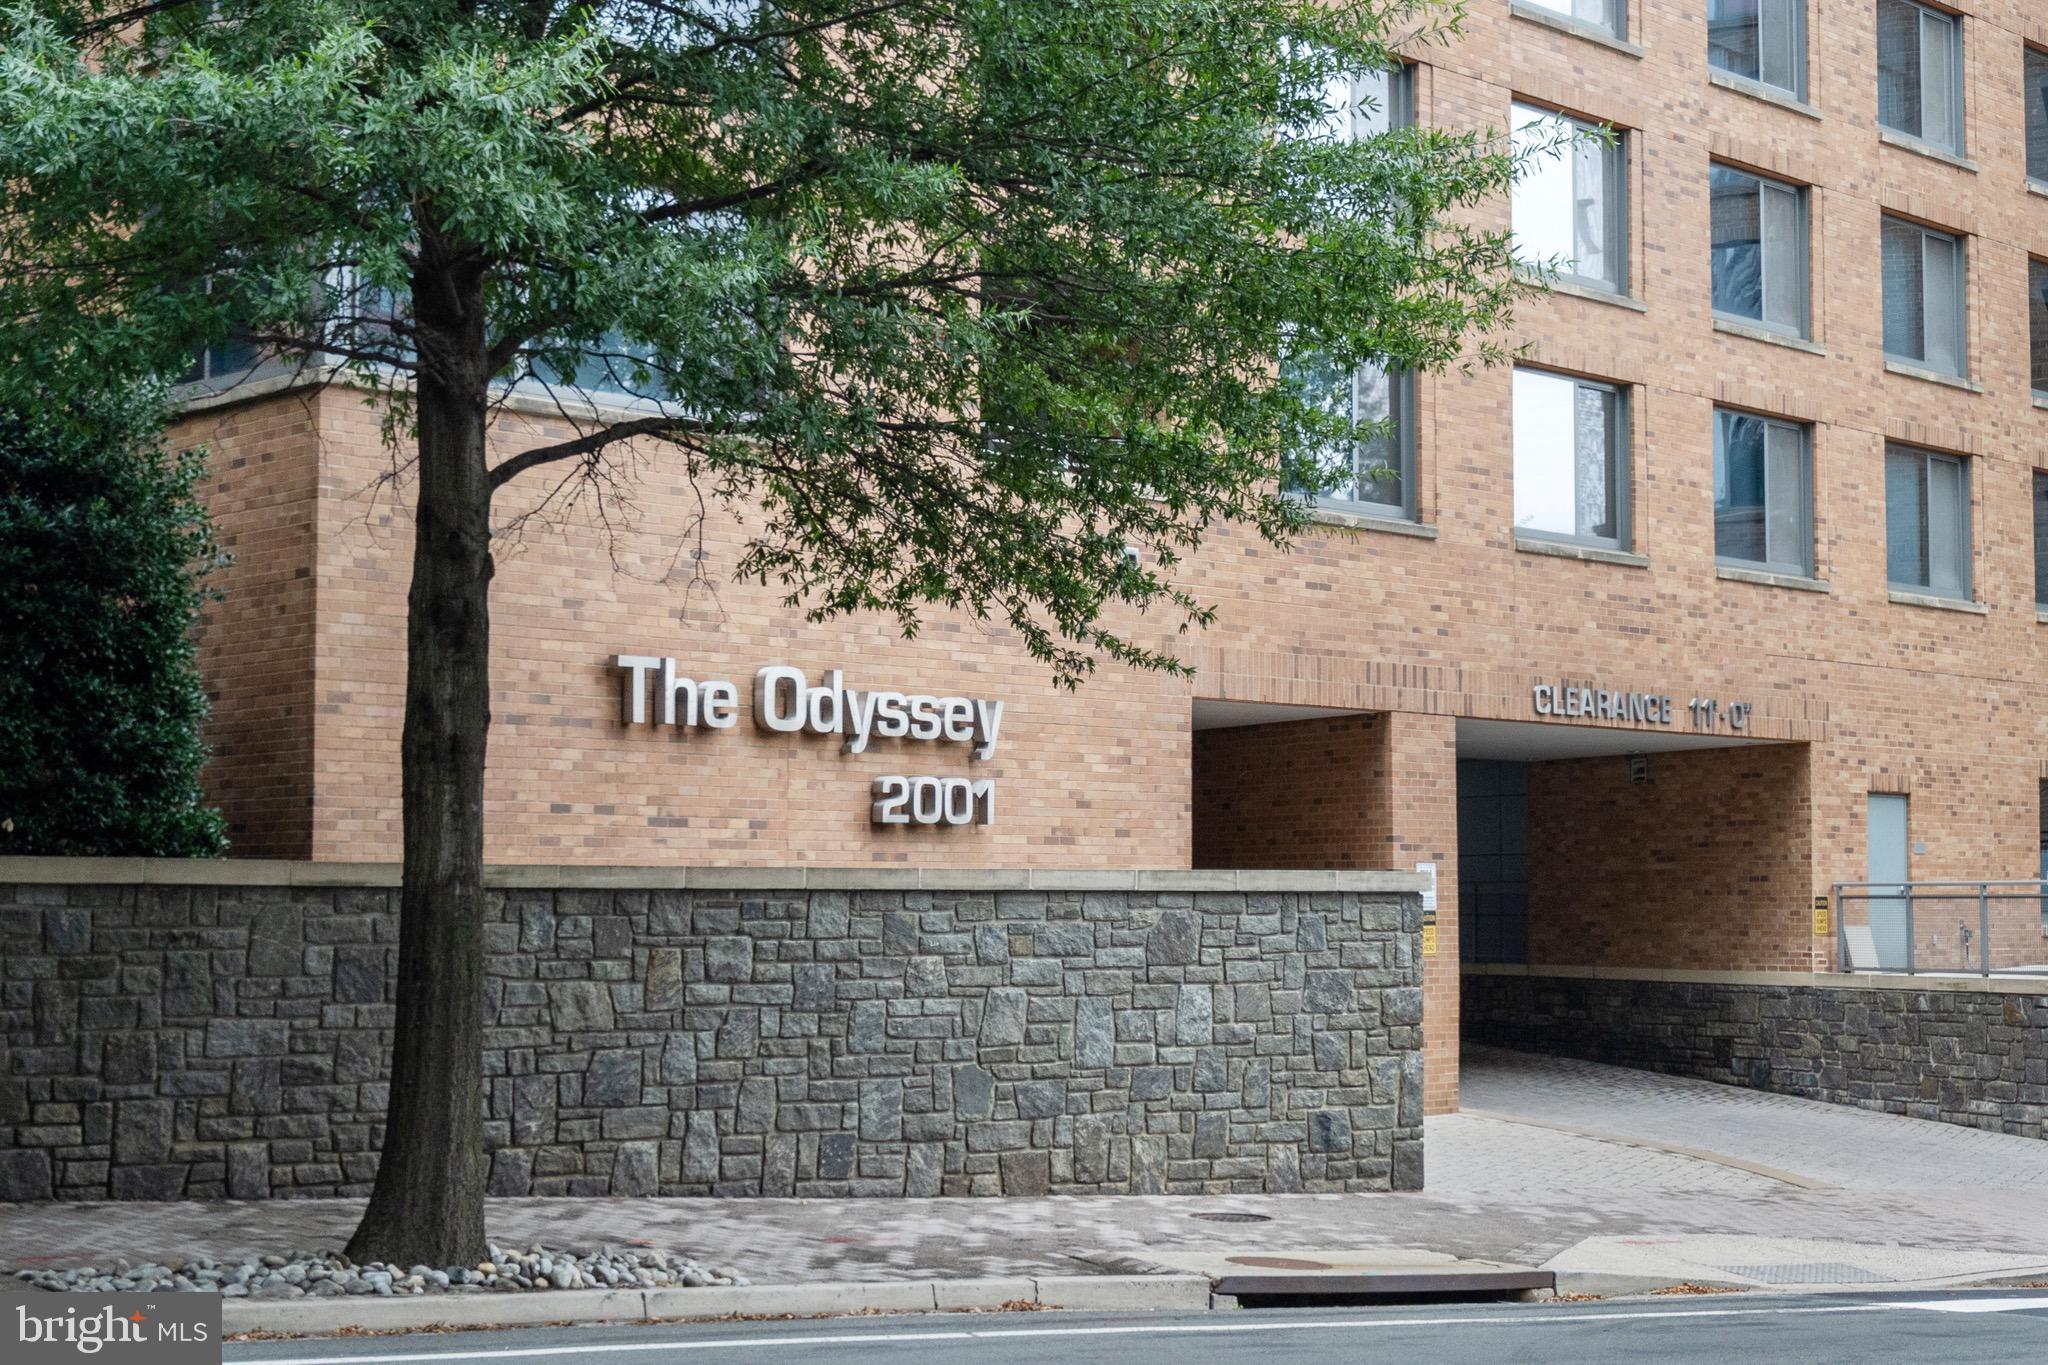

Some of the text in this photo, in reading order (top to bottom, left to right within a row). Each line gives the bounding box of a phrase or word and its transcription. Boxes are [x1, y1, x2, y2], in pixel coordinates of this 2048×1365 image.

[612, 655, 1003, 760] The Odyssey
[1535, 684, 1673, 723] CLEARANCE
[876, 775, 995, 826] 2001
